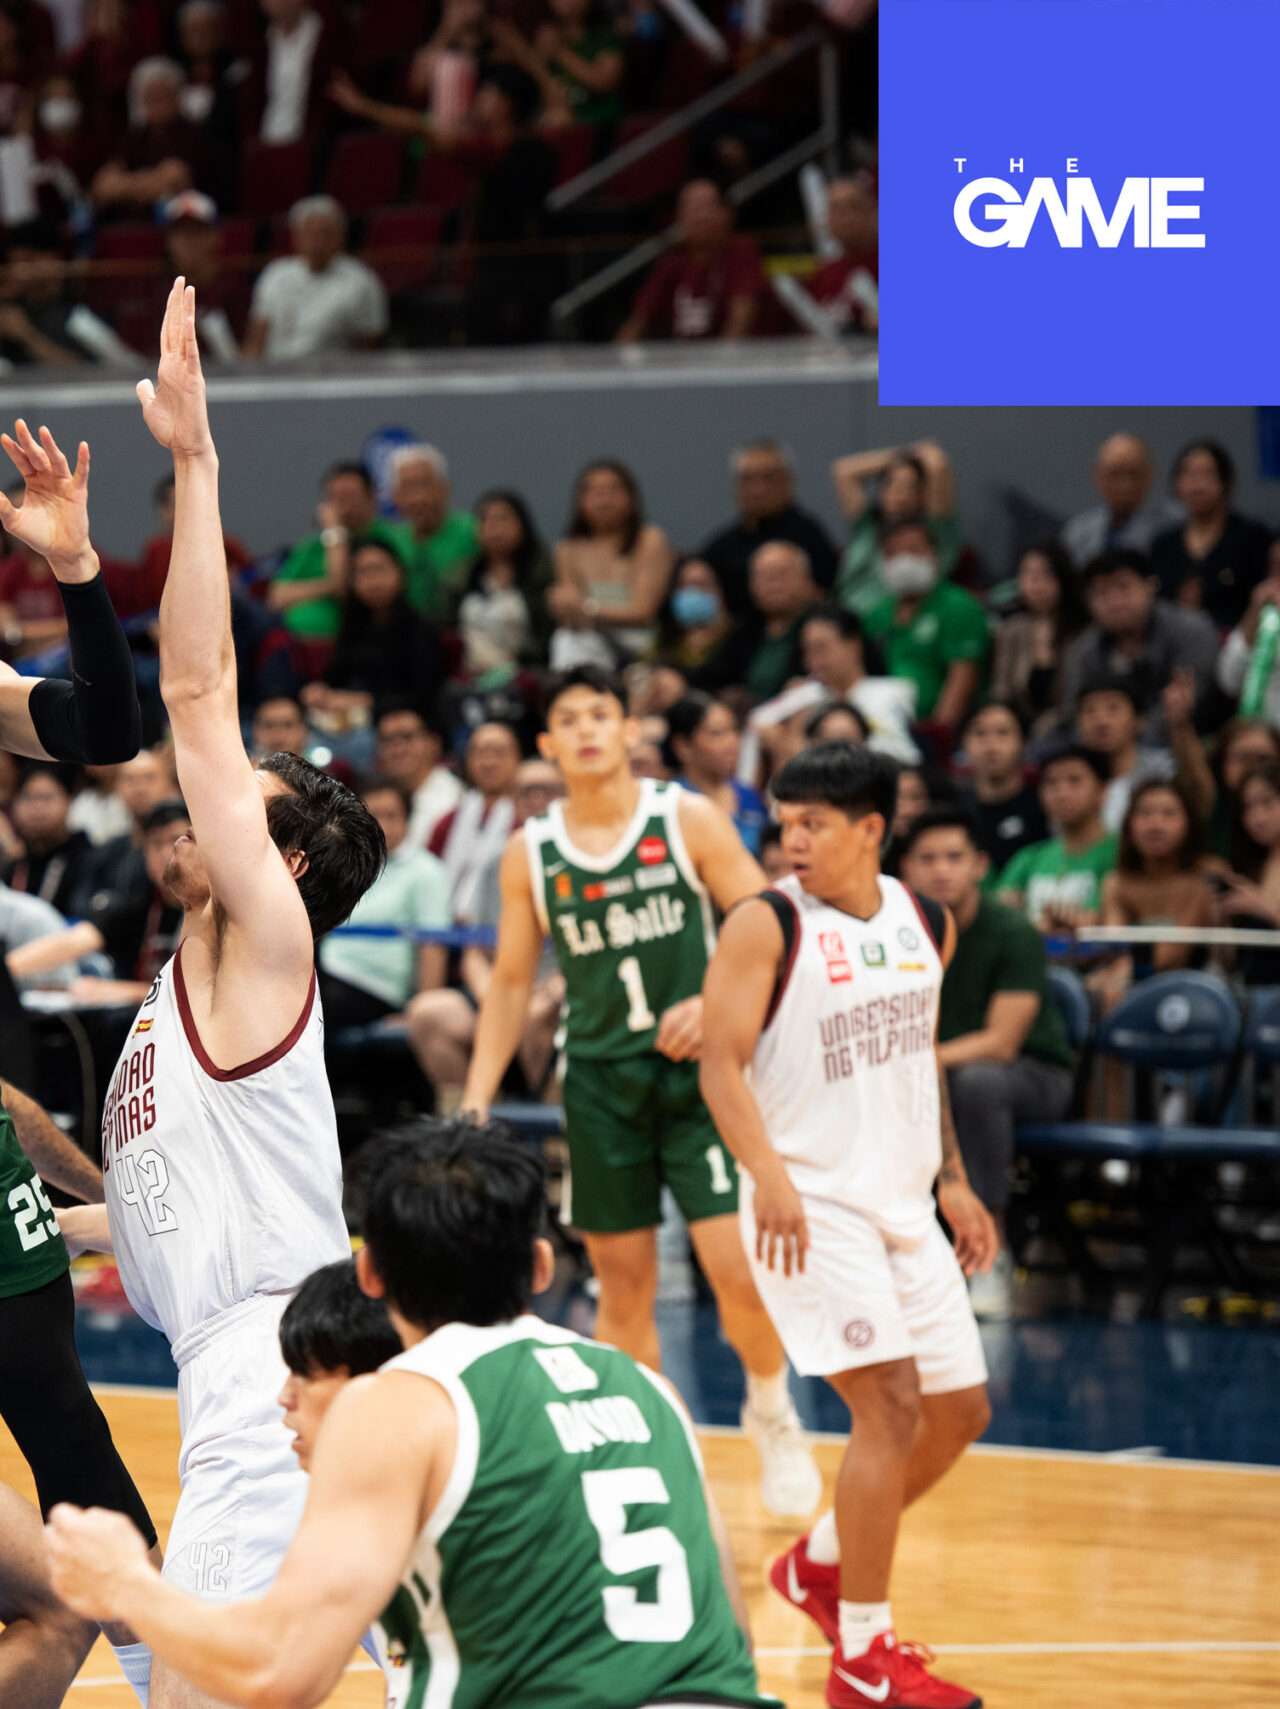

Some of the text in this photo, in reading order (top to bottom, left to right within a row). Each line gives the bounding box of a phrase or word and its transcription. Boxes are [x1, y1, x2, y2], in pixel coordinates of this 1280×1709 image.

[556, 892, 686, 958] La Salle
[617, 955, 656, 1033] 1
[115, 1148, 179, 1237] 42
[704, 1145, 732, 1194] 1
[188, 1542, 231, 1592] 42
[580, 1466, 695, 1643] 5
